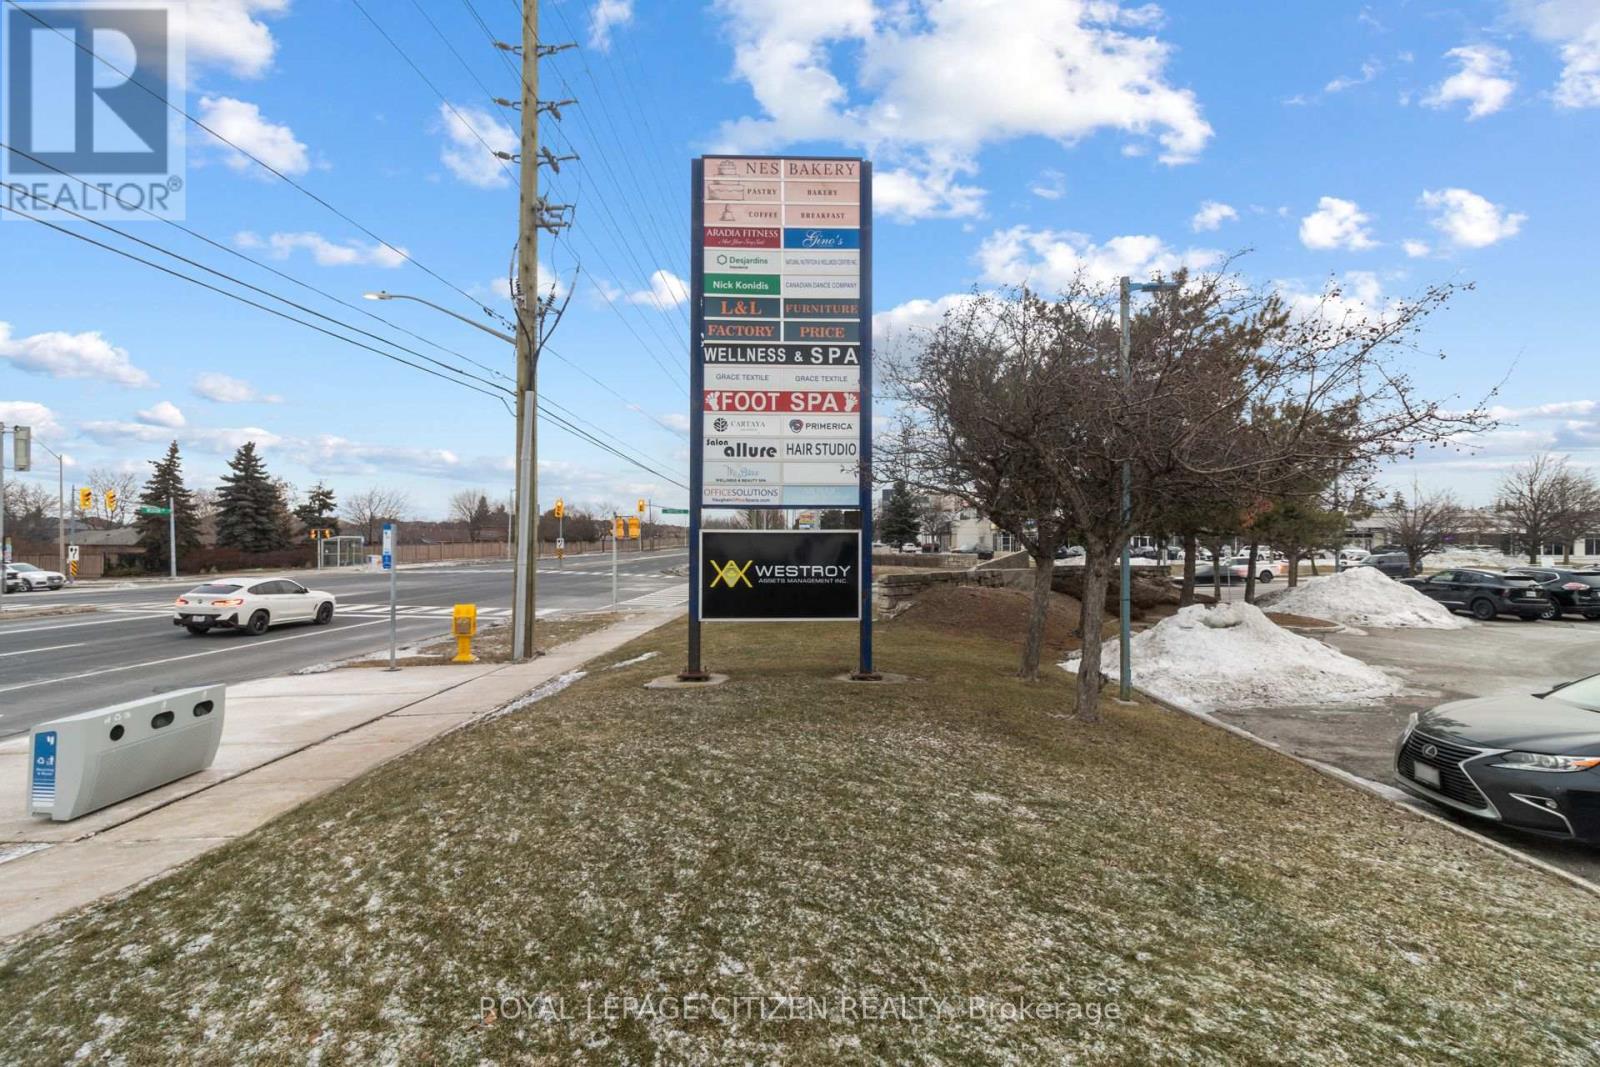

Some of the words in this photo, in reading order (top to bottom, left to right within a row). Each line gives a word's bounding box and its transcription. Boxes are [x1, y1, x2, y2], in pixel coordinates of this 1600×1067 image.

[746, 162, 780, 176] NES
[789, 163, 855, 176] BAKERY
[747, 188, 777, 196] PASTRY
[706, 228, 742, 237] ARADIA
[742, 229, 779, 238] FITNESS
[802, 230, 843, 247] Gino's
[729, 256, 768, 265] Desjardins
[713, 280, 733, 289] Nick
[735, 281, 769, 290] Konidis
[720, 300, 762, 315] L&L
[786, 304, 858, 314] FURNITURE
[708, 324, 775, 337] FACTORY
[800, 326, 845, 338] PRICE
[704, 347, 786, 363] WELLNESS
[794, 351, 804, 363] &
[810, 347, 859, 364] SPA
[742, 374, 769, 382] TEXTILE
[721, 392, 780, 411] FOOT
[789, 392, 839, 412] SPA
[724, 443, 777, 458] allure
[786, 443, 815, 455] HAIR
[815, 443, 857, 456] STUDIO
[755, 565, 850, 577] WESTROY
